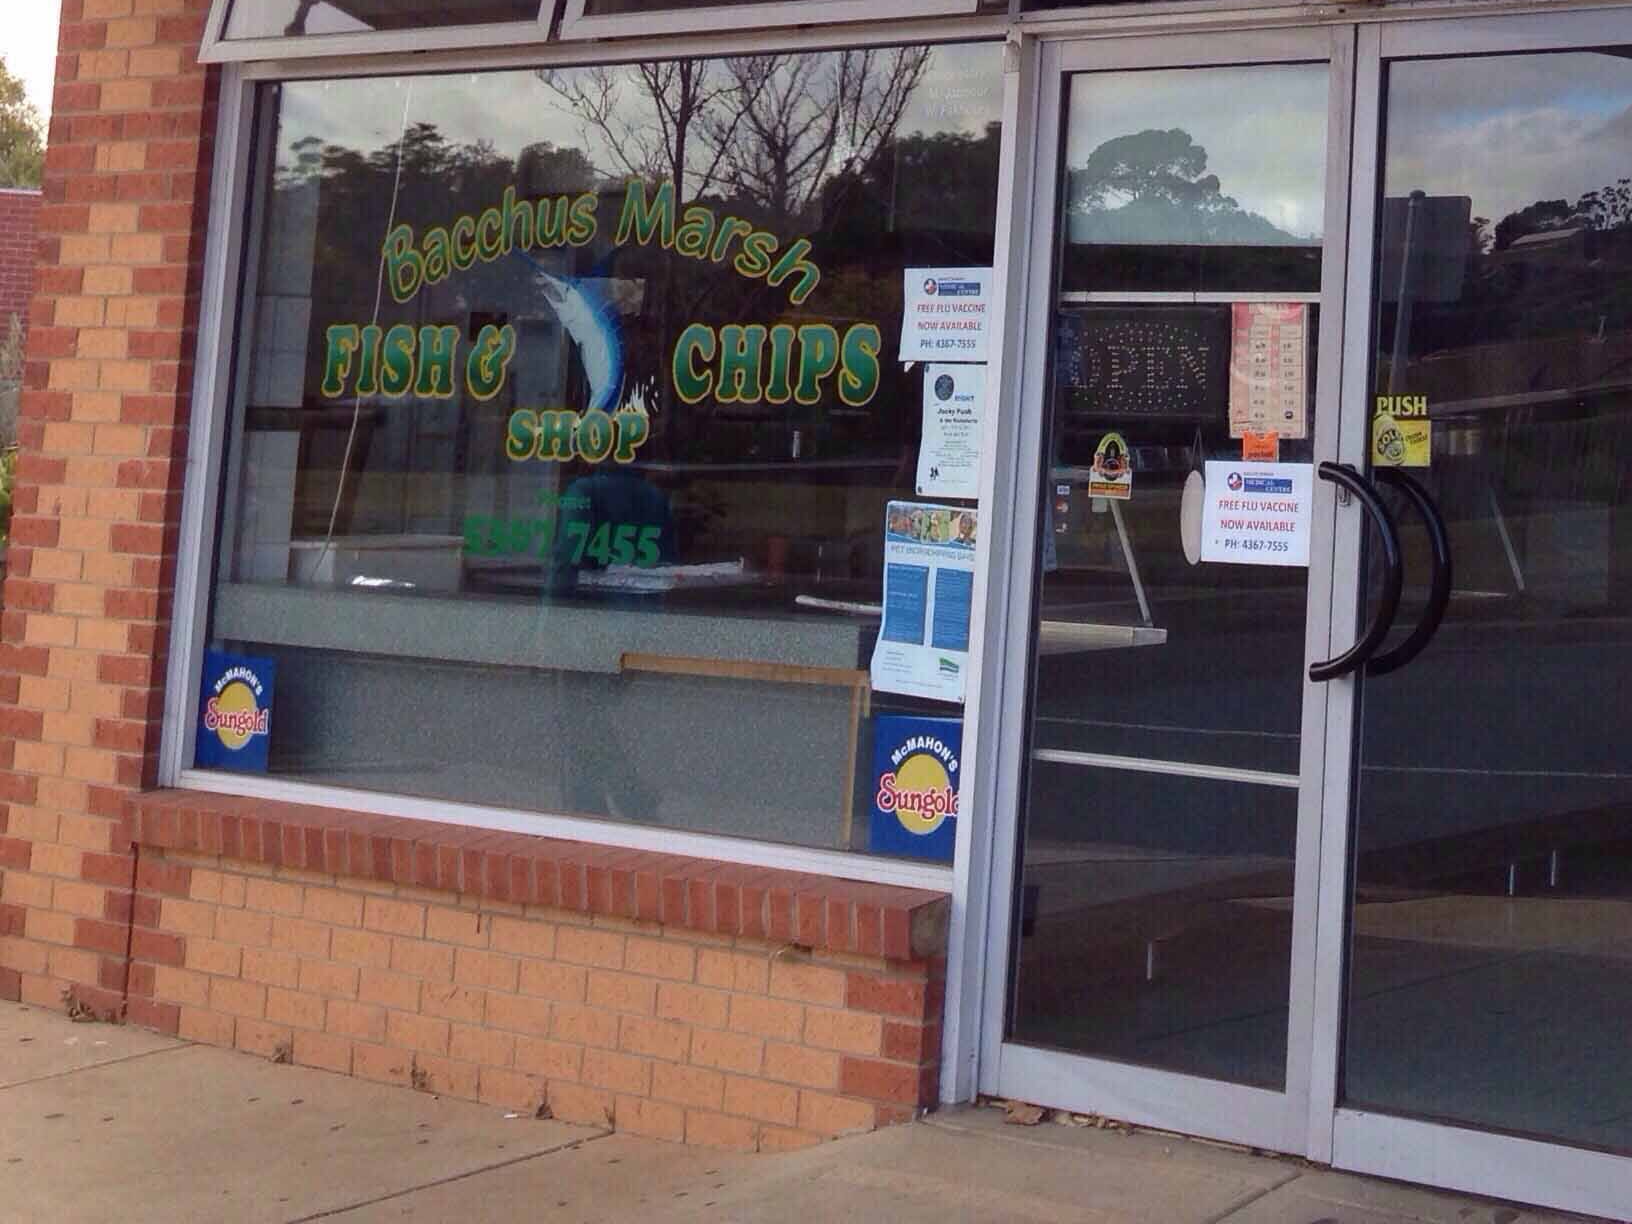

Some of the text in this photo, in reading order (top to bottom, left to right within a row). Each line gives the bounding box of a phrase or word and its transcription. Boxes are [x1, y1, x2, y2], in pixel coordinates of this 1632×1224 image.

[382, 176, 821, 305] Bacchus Marsh
[952, 303, 986, 313] VACCINE
[917, 321, 983, 331] NOW AVAILABLE
[321, 322, 882, 406] FISH & CHIPS
[1071, 346, 1210, 389] OPEN
[1376, 396, 1427, 416] PUSH
[506, 408, 650, 465] SHOP
[1219, 500, 1299, 513] FREE FLU VACCINE
[1221, 520, 1296, 532] NOW AVAILABLE
[566, 521, 662, 569] 7455
[1225, 539, 1288, 552] PH: 4367-7555
[214, 666, 264, 696] McMAHON'S
[204, 696, 269, 737] Sungold
[891, 736, 958, 773] McMAHON'S
